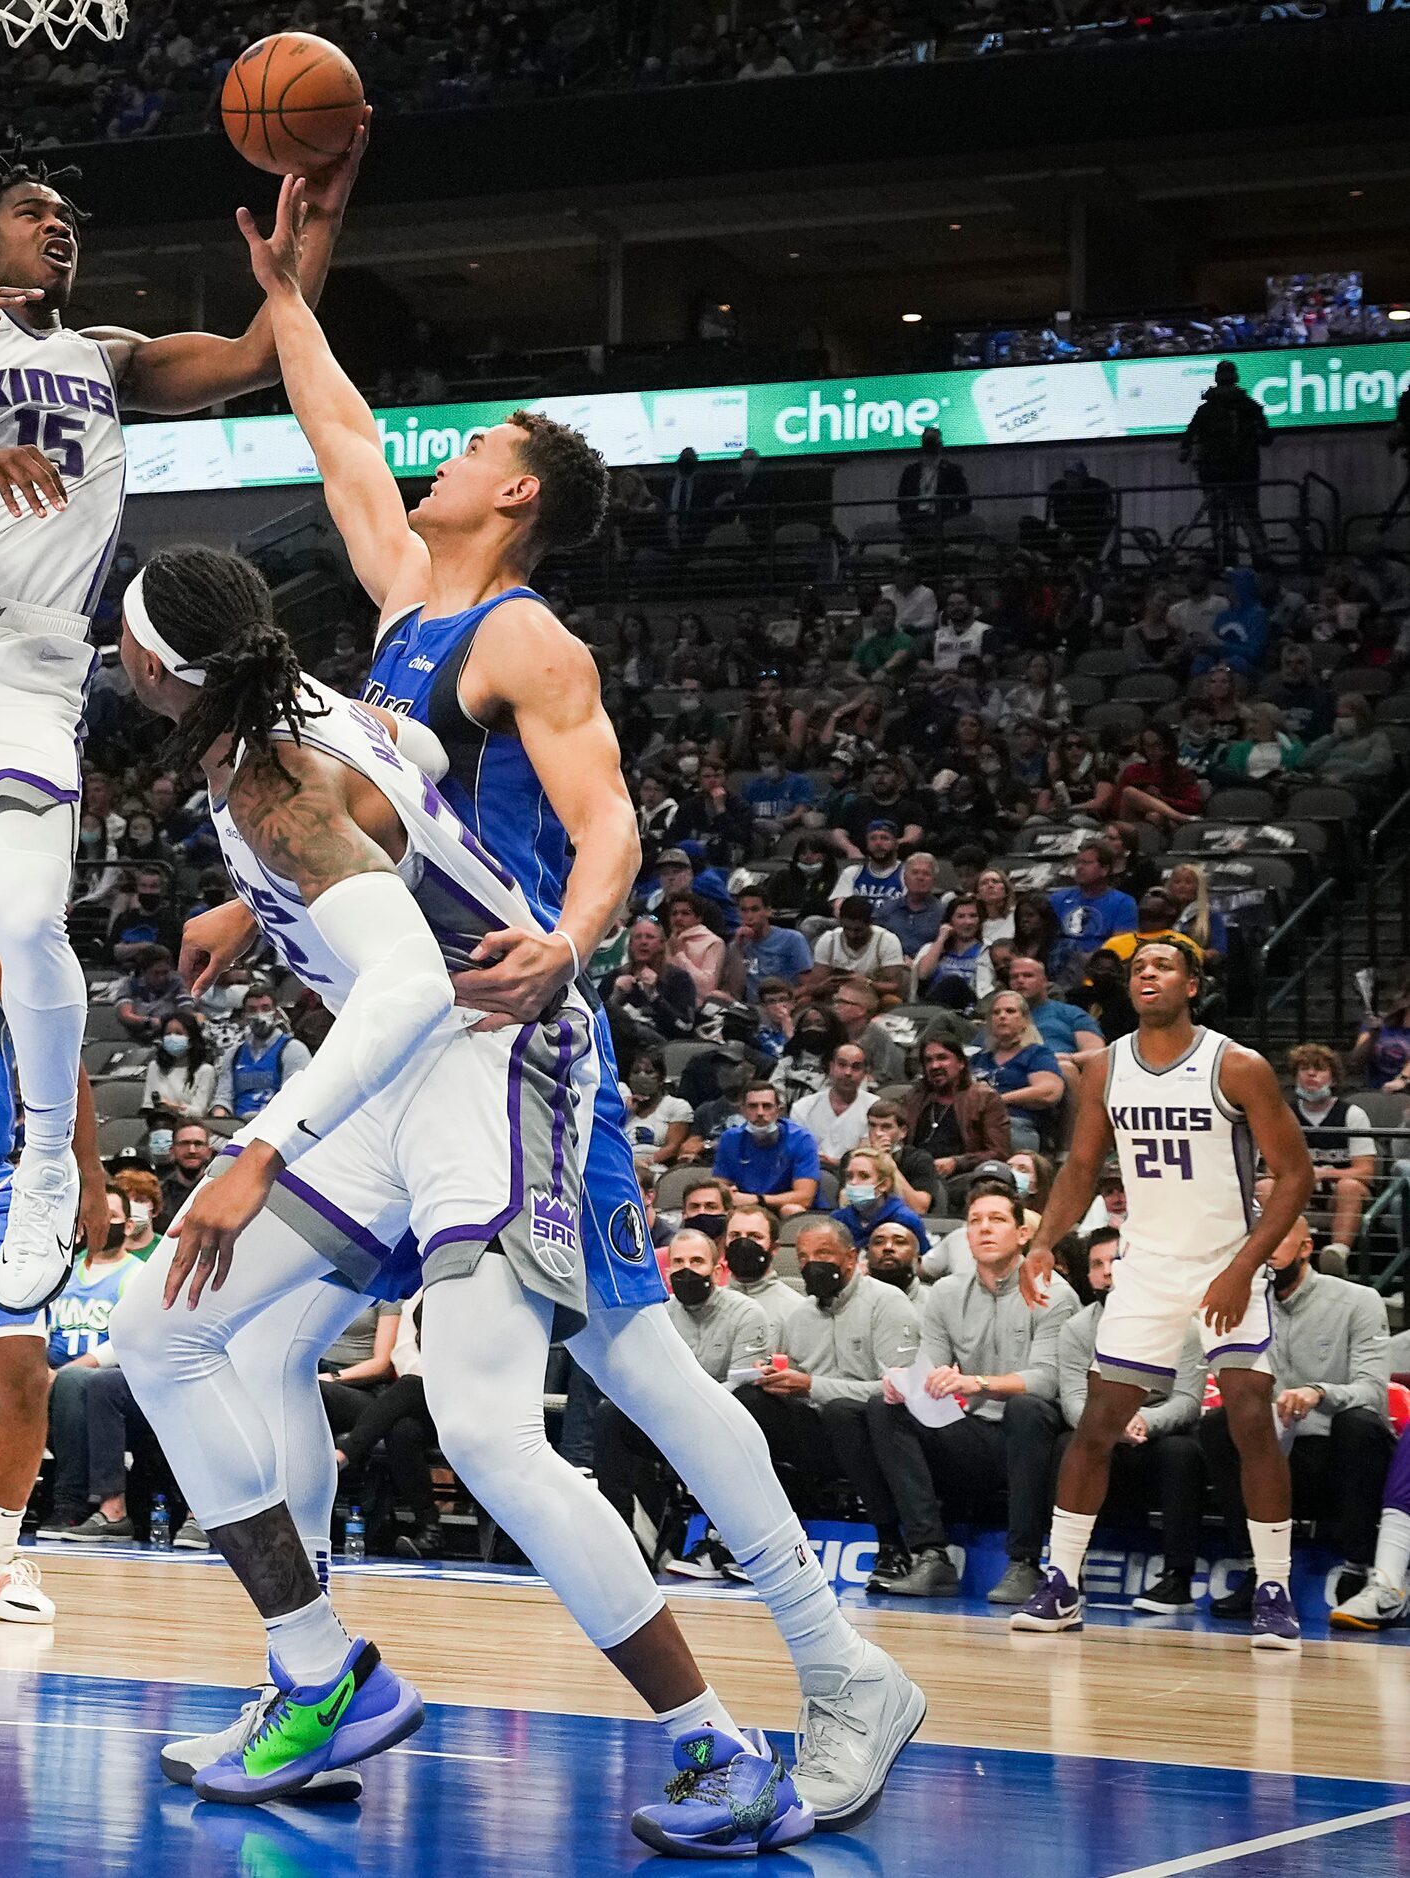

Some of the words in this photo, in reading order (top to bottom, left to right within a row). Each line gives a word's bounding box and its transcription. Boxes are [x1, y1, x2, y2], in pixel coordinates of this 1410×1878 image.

[375, 416, 491, 467] him
[774, 388, 940, 444] chime
[14, 408, 87, 479] 15
[1110, 1106, 1213, 1132] KINGS
[1131, 1138, 1194, 1180] 24
